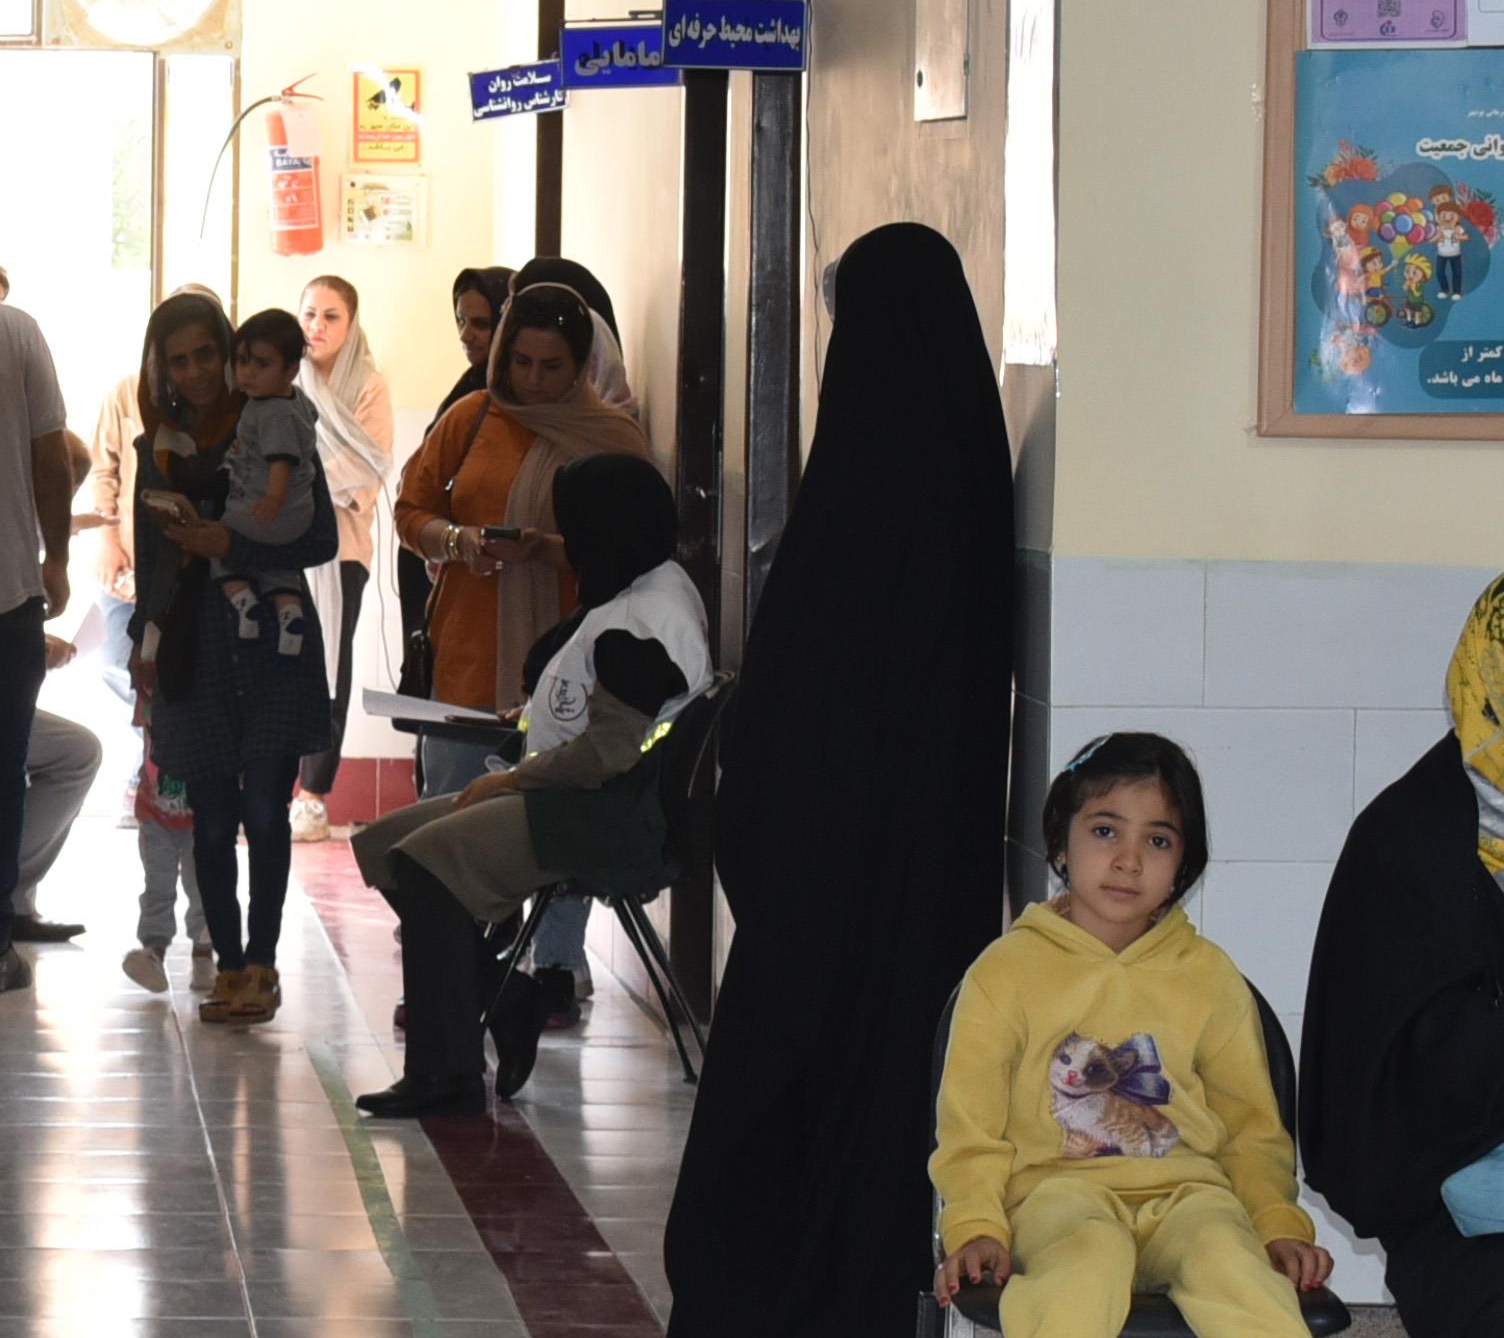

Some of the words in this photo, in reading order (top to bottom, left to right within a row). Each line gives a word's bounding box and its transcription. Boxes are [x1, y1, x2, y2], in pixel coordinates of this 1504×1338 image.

[688, 13, 717, 49] حرفه
[719, 15, 752, 49] محیط
[755, 18, 801, 51] بهداشت
[488, 74, 512, 93] روان
[473, 95, 522, 118] روانشناسی
[1418, 138, 1469, 159] جمعیت
[1477, 344, 1503, 361] کمتر
[1484, 368, 1503, 384] ماه
